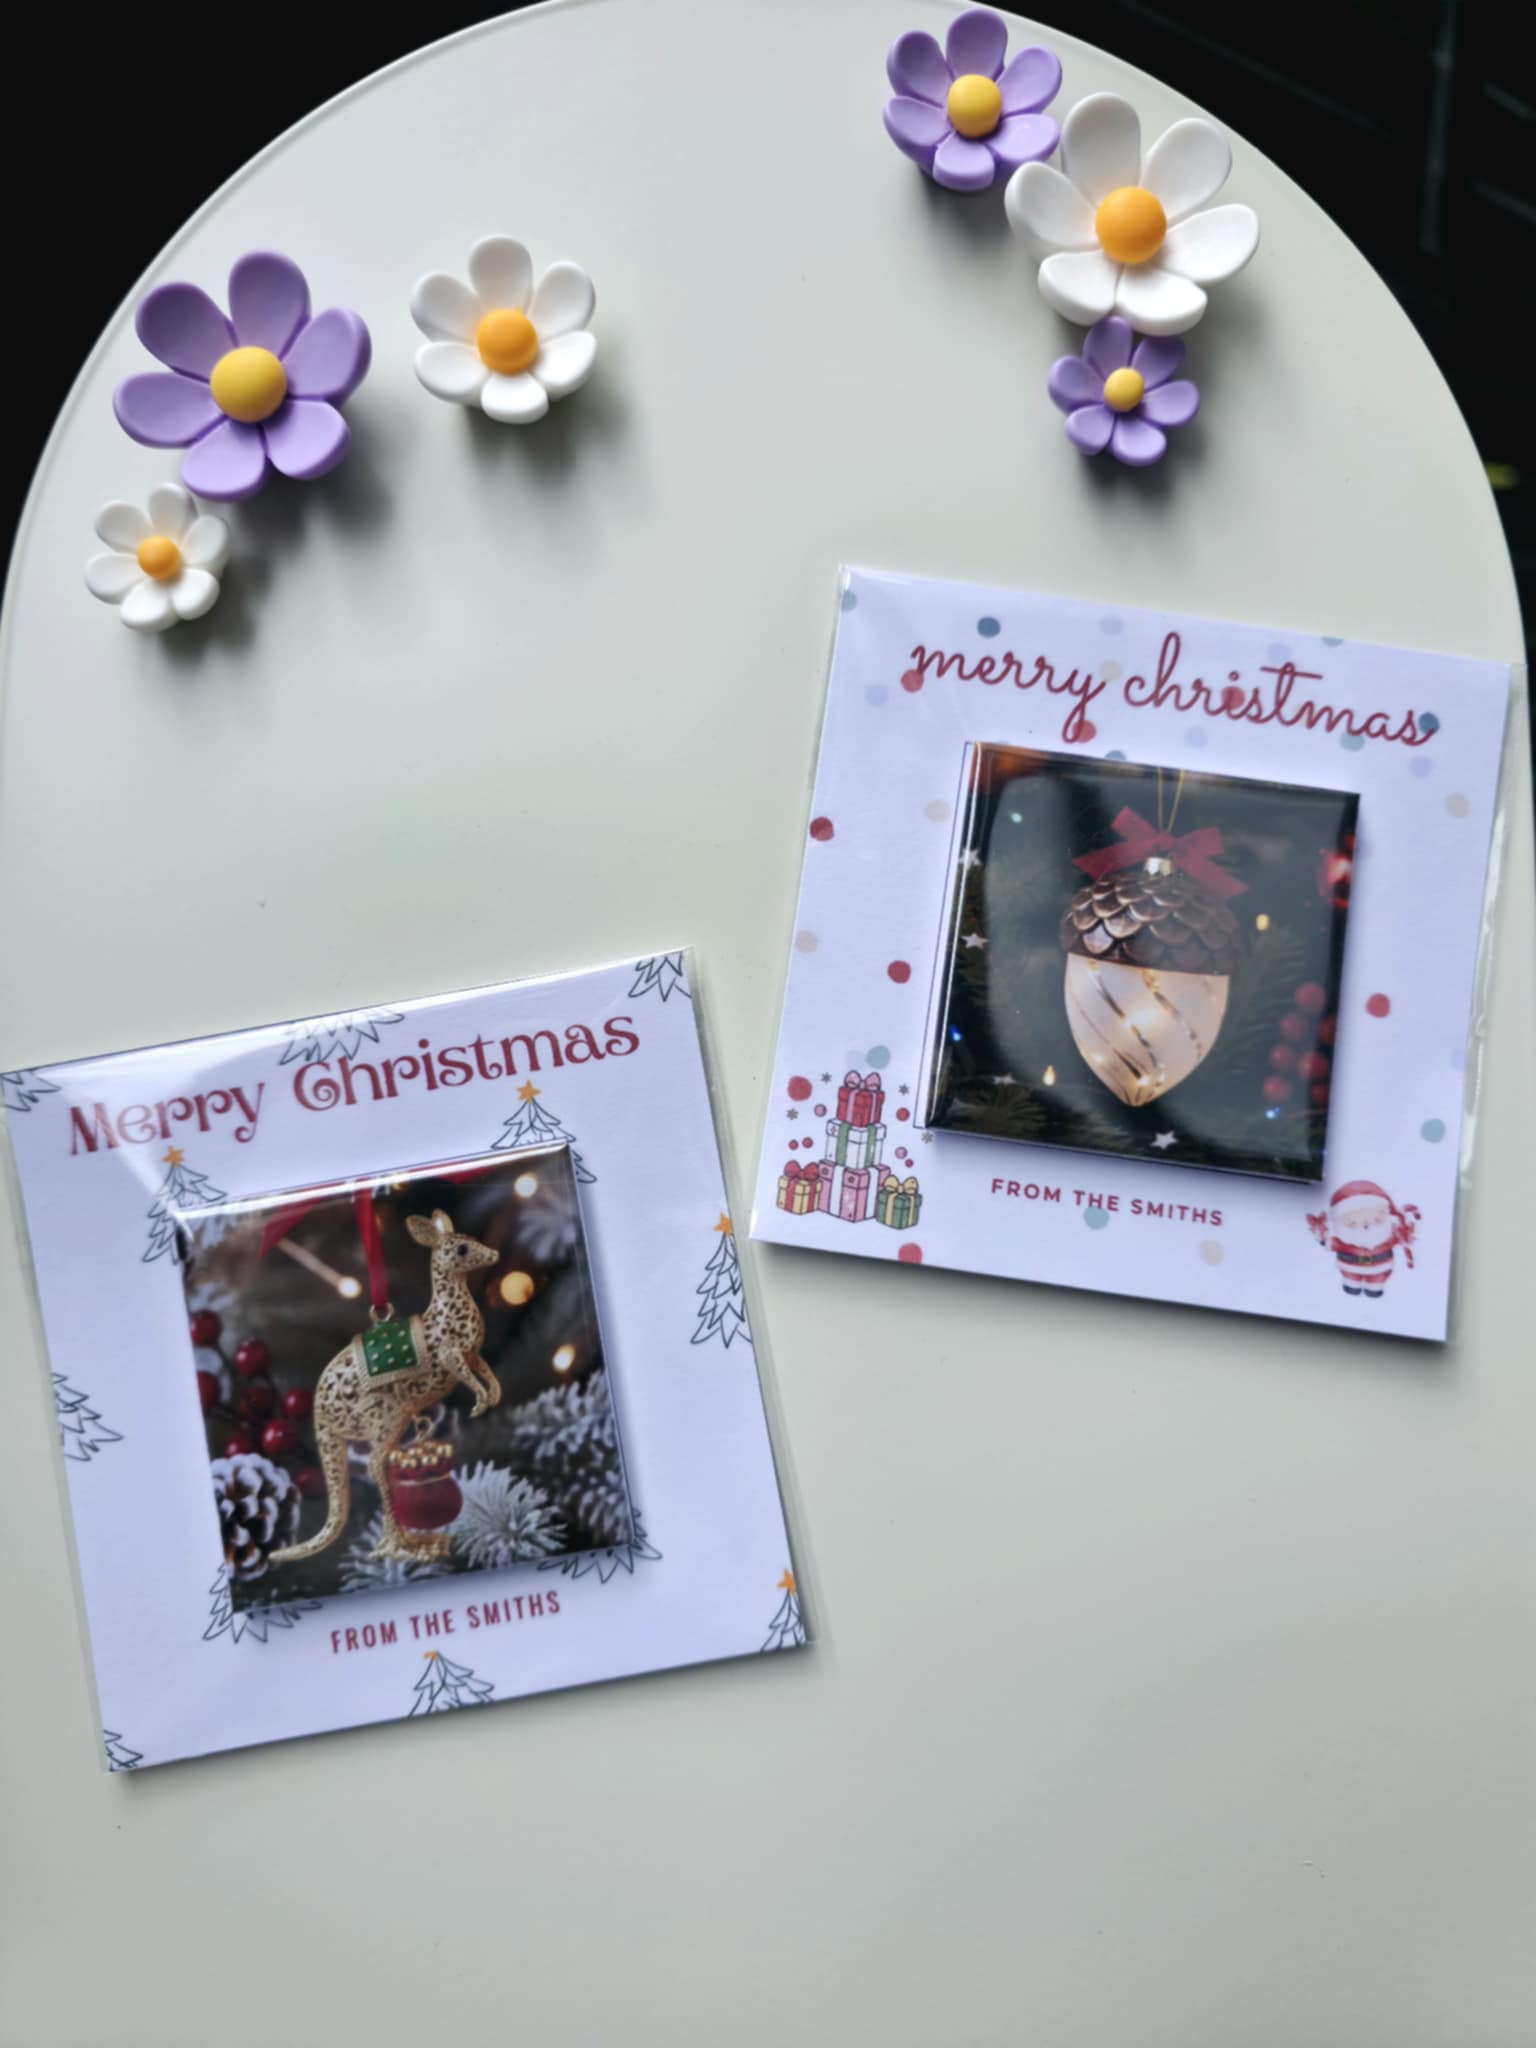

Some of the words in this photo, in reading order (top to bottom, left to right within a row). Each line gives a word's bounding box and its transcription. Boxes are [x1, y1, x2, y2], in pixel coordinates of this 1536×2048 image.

[911, 644, 1107, 744] merry
[1123, 631, 1437, 747] christmas
[69, 1081, 265, 1157] Merry
[292, 1014, 641, 1113] Christmas
[991, 1178, 1061, 1203] FROM
[1073, 1189, 1120, 1212] THE
[1130, 1198, 1223, 1227] SMITHS
[331, 1620, 398, 1654] FROM
[410, 1608, 456, 1639] THE
[466, 1589, 561, 1630] SMITHS
